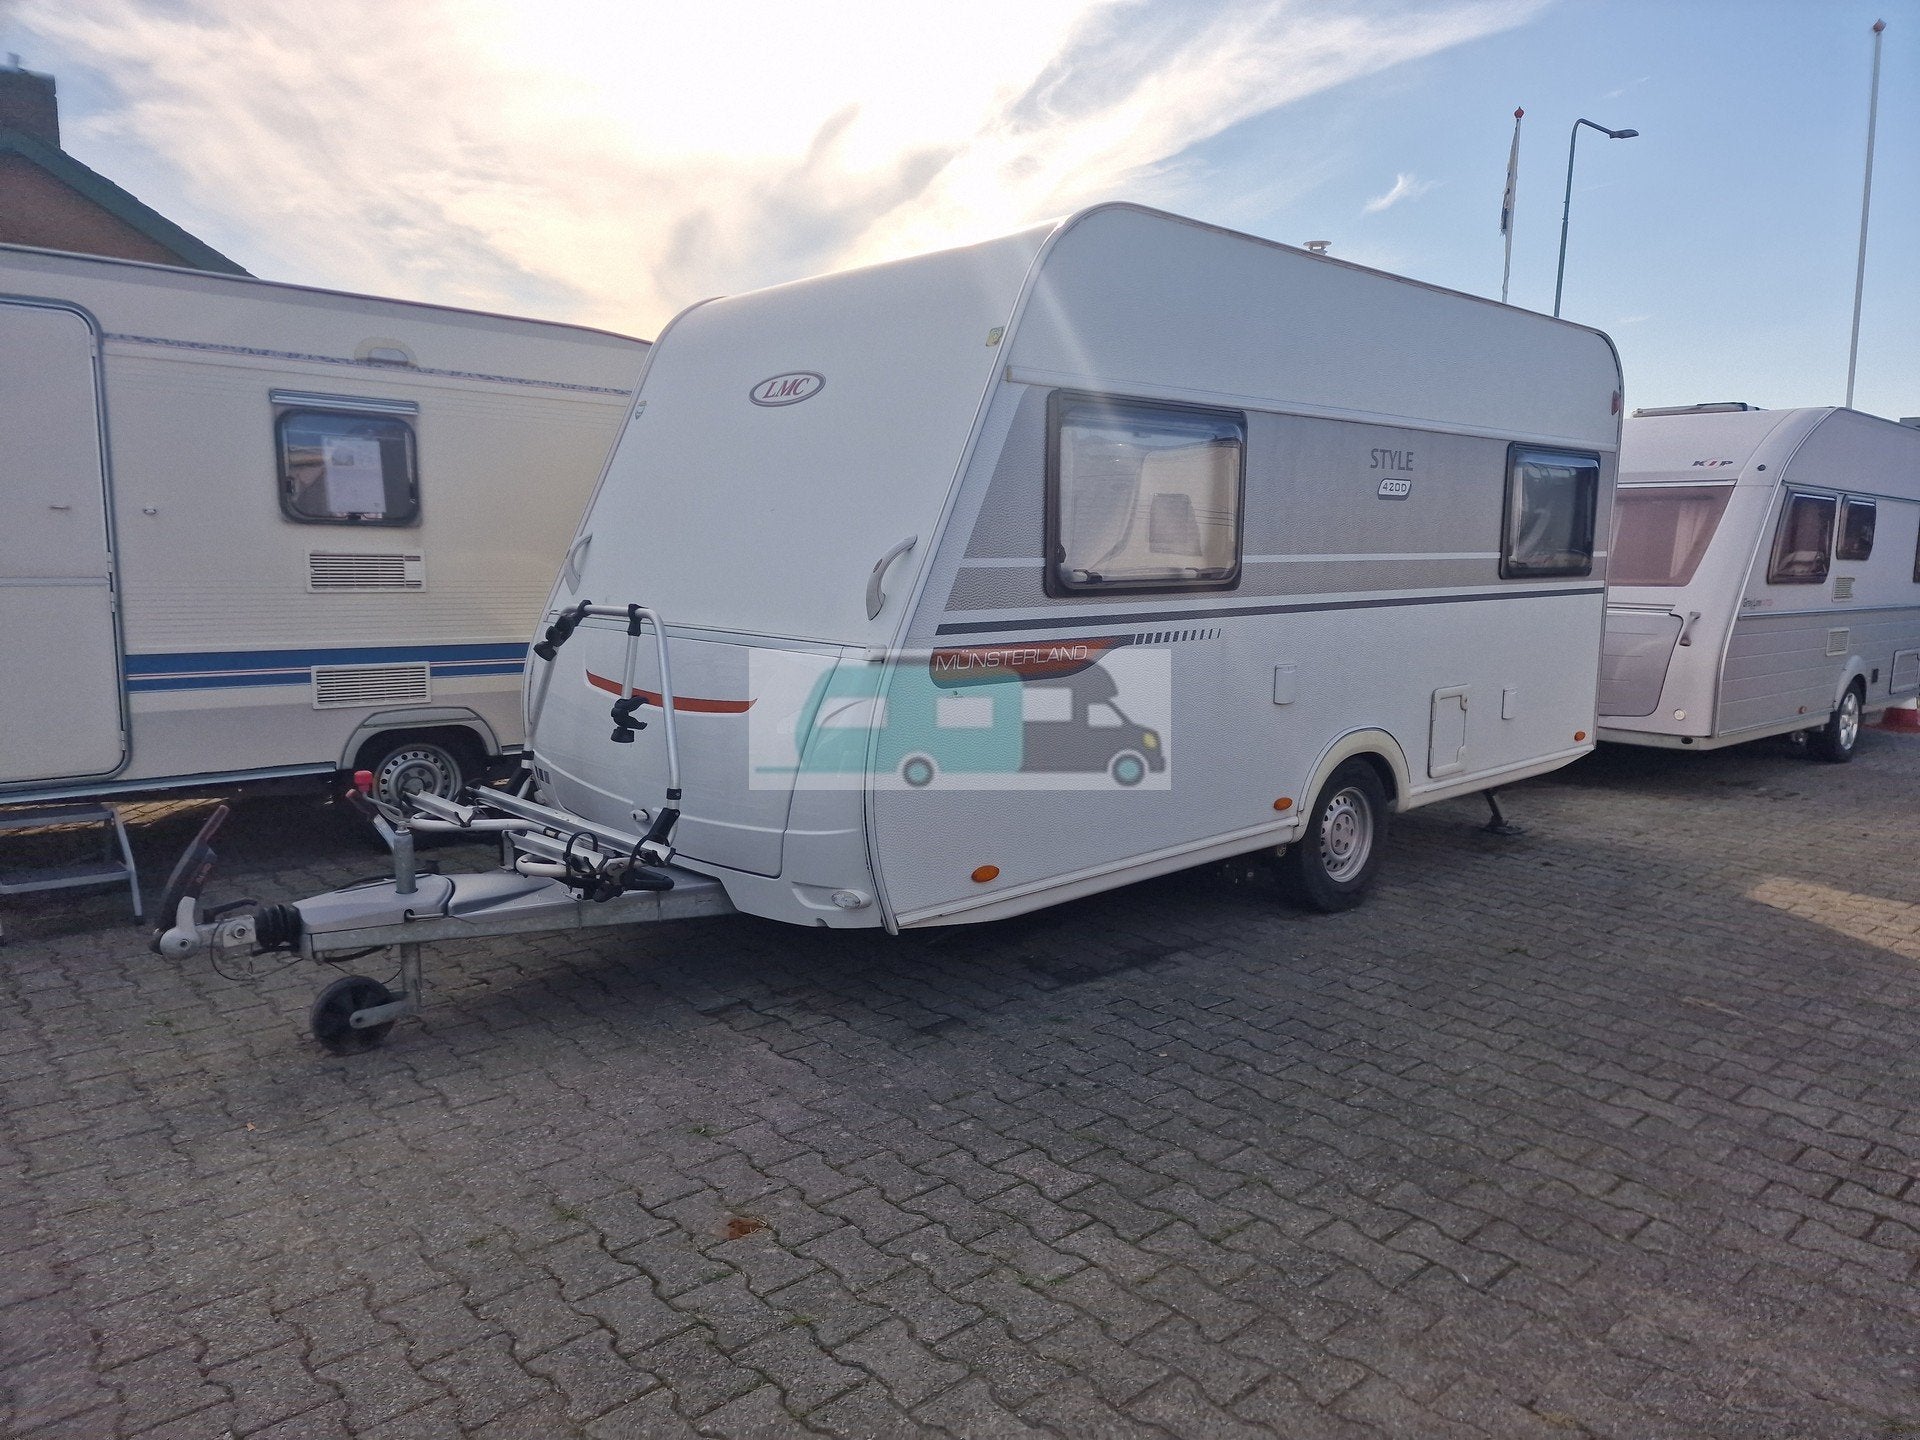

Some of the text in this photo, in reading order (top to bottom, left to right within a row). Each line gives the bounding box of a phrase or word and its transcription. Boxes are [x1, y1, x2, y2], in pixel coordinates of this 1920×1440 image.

[762, 378, 811, 399] LMC
[1370, 448, 1414, 471] STYLE
[935, 645, 1088, 671] MÜNSTERLAND
